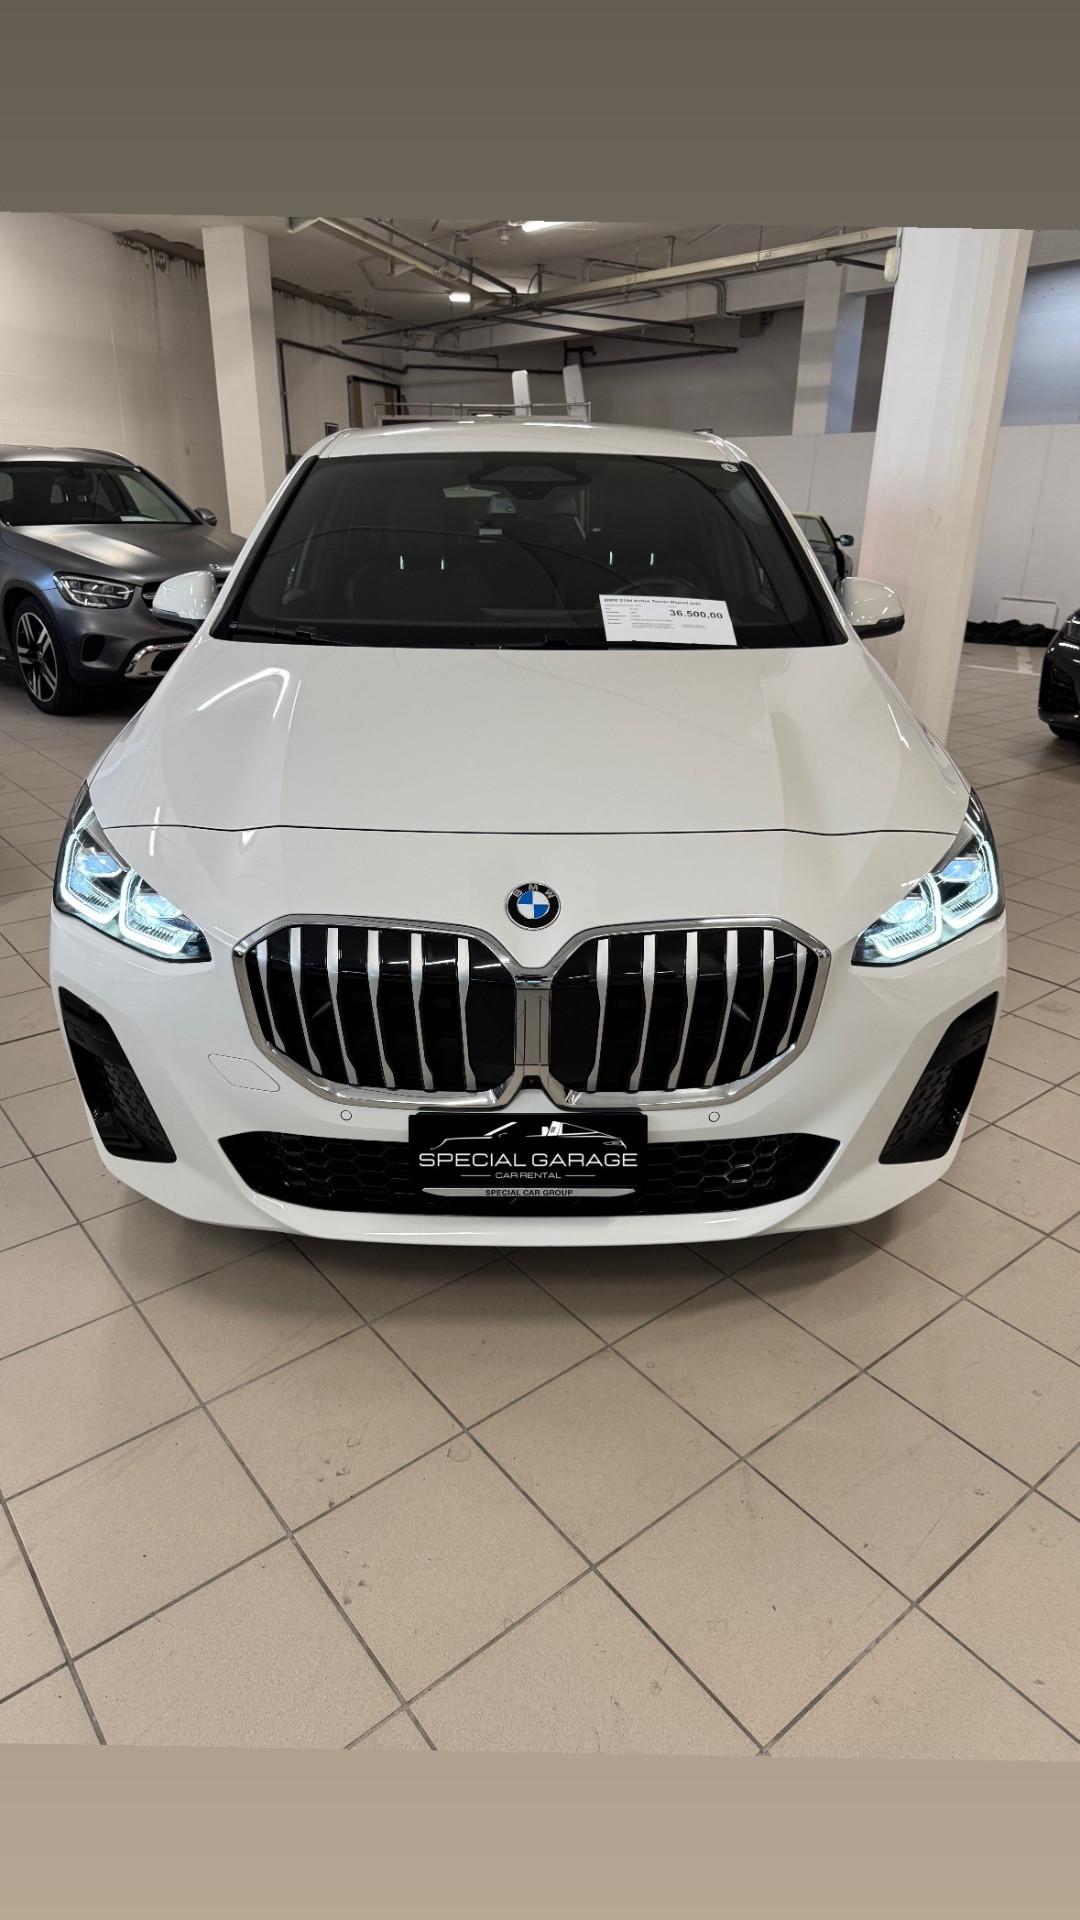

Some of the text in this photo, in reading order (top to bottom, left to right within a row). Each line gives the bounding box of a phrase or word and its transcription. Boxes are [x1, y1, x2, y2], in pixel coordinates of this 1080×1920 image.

[669, 609, 723, 619] 36.500,00
[512, 883, 556, 898] BMW
[418, 1152, 638, 1167] SPECIAL GARAGE
[495, 1171, 562, 1179] CAR RENTAL
[485, 1189, 574, 1197] SPECIAL CAR GROUP
